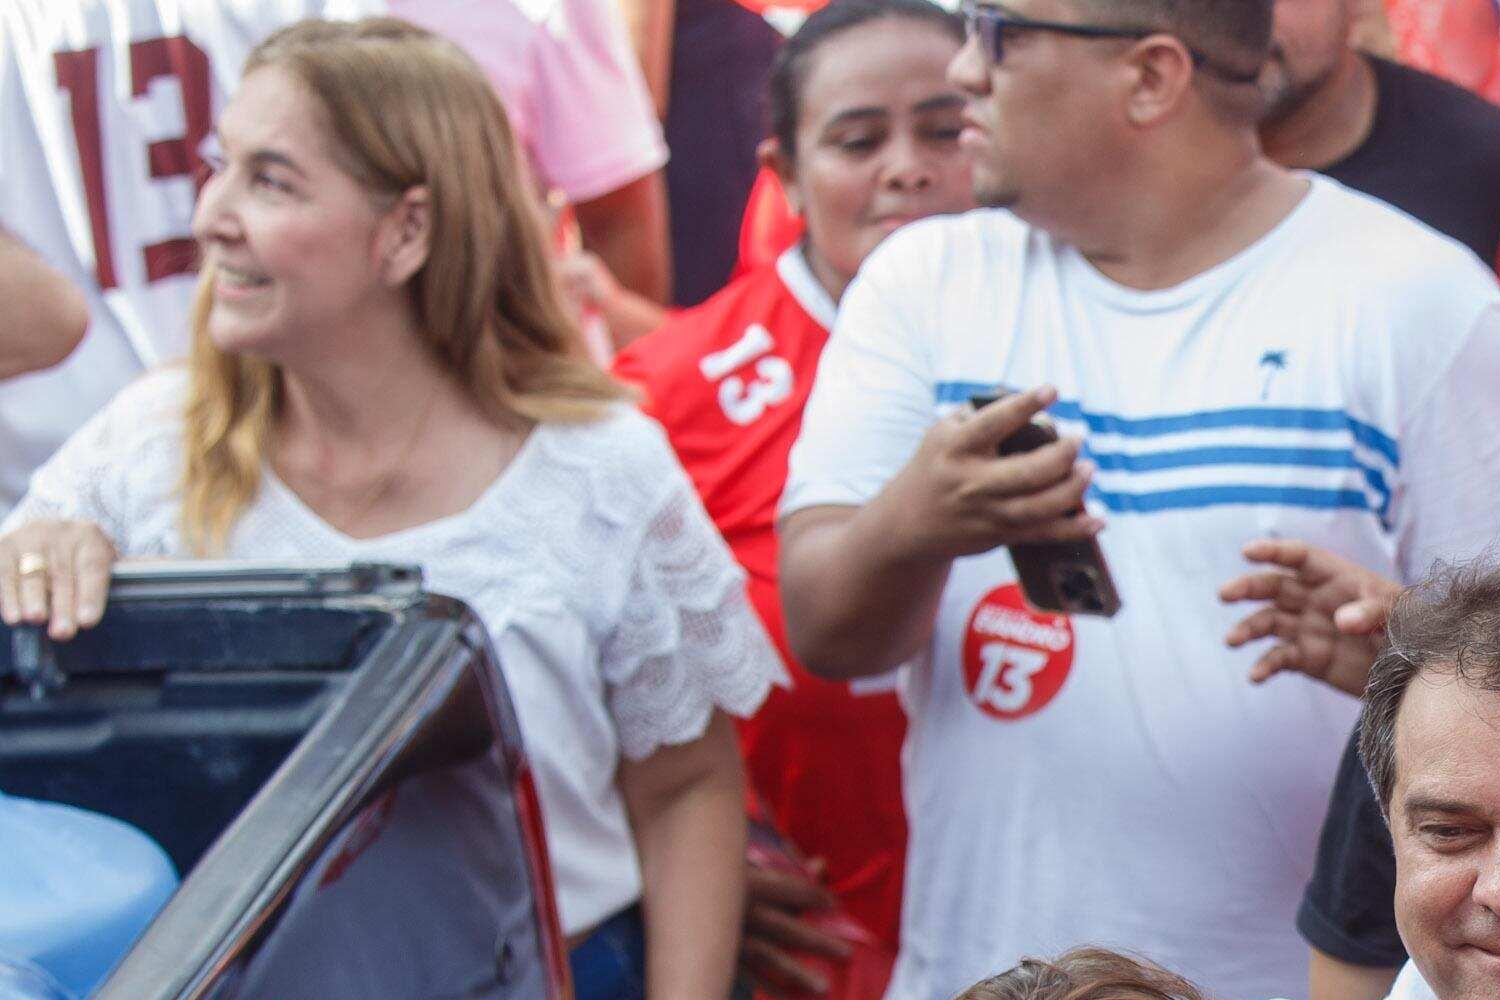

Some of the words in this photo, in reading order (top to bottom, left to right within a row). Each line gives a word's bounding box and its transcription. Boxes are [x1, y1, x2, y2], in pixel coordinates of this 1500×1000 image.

[53, 36, 212, 290] 13
[699, 322, 795, 426] 13
[975, 643, 1048, 711] 13
